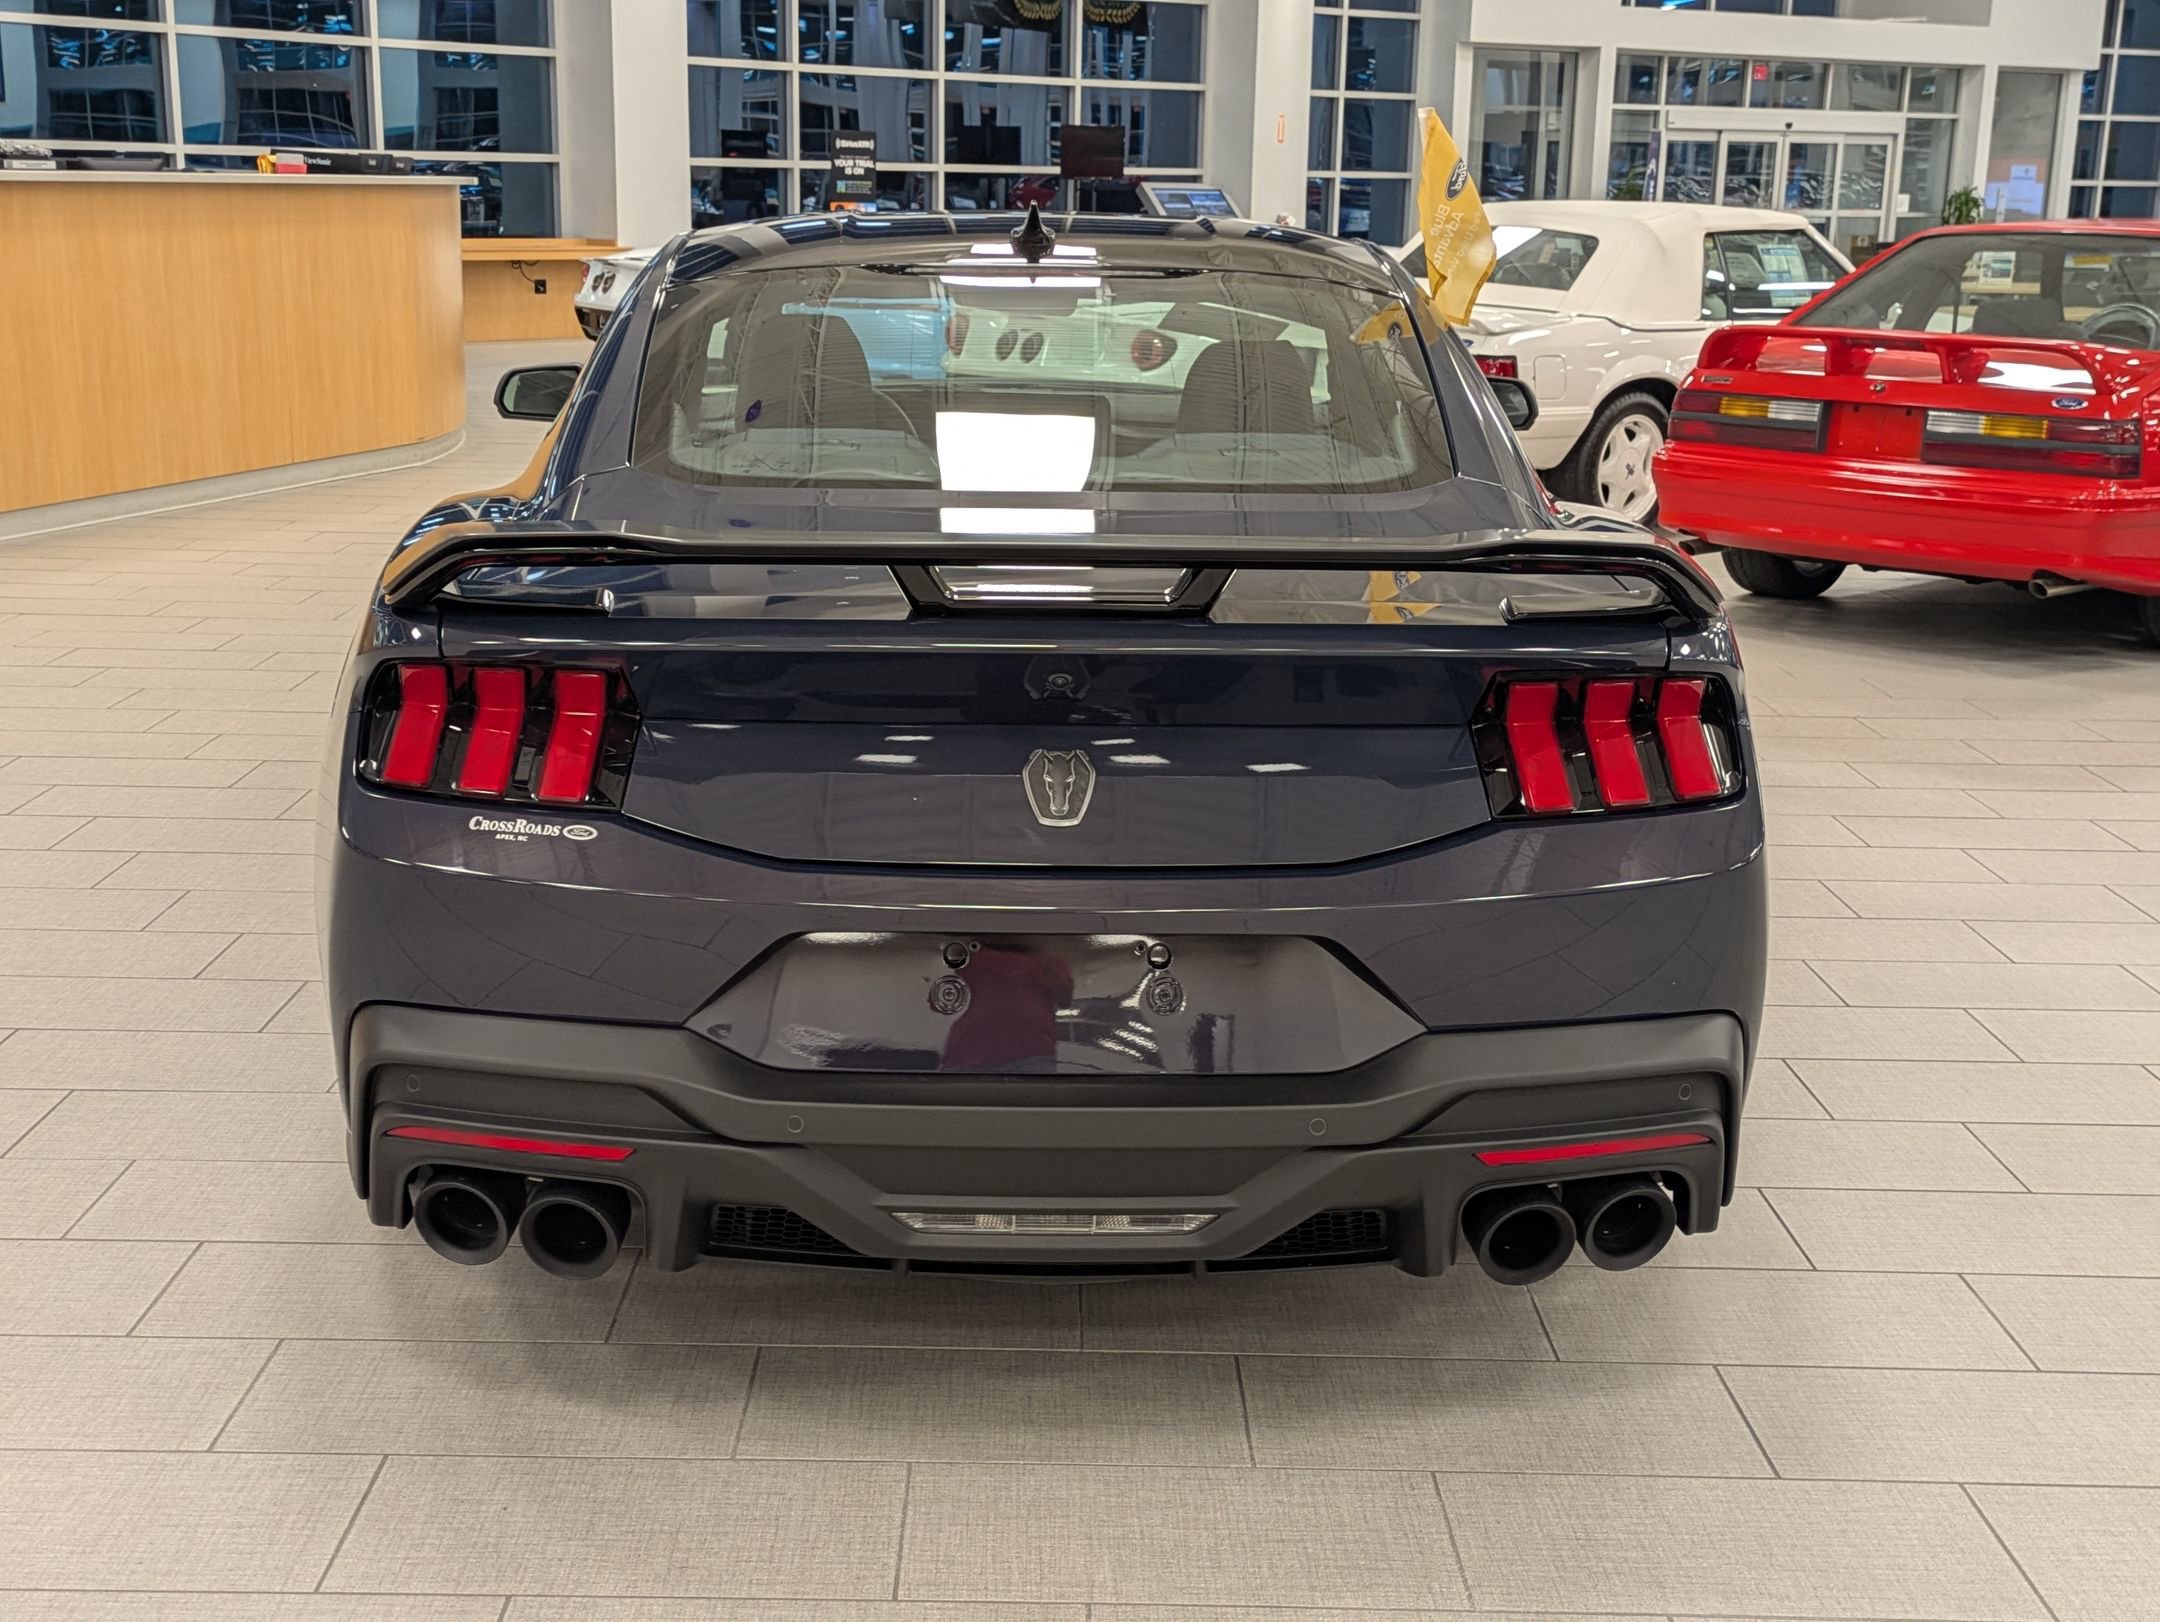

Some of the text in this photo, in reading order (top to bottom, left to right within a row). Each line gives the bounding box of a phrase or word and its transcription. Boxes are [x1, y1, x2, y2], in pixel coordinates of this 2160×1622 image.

[834, 159, 875, 168] YOUR TRIAL
[844, 167, 852, 175] IS
[495, 833, 516, 841] APEX,
